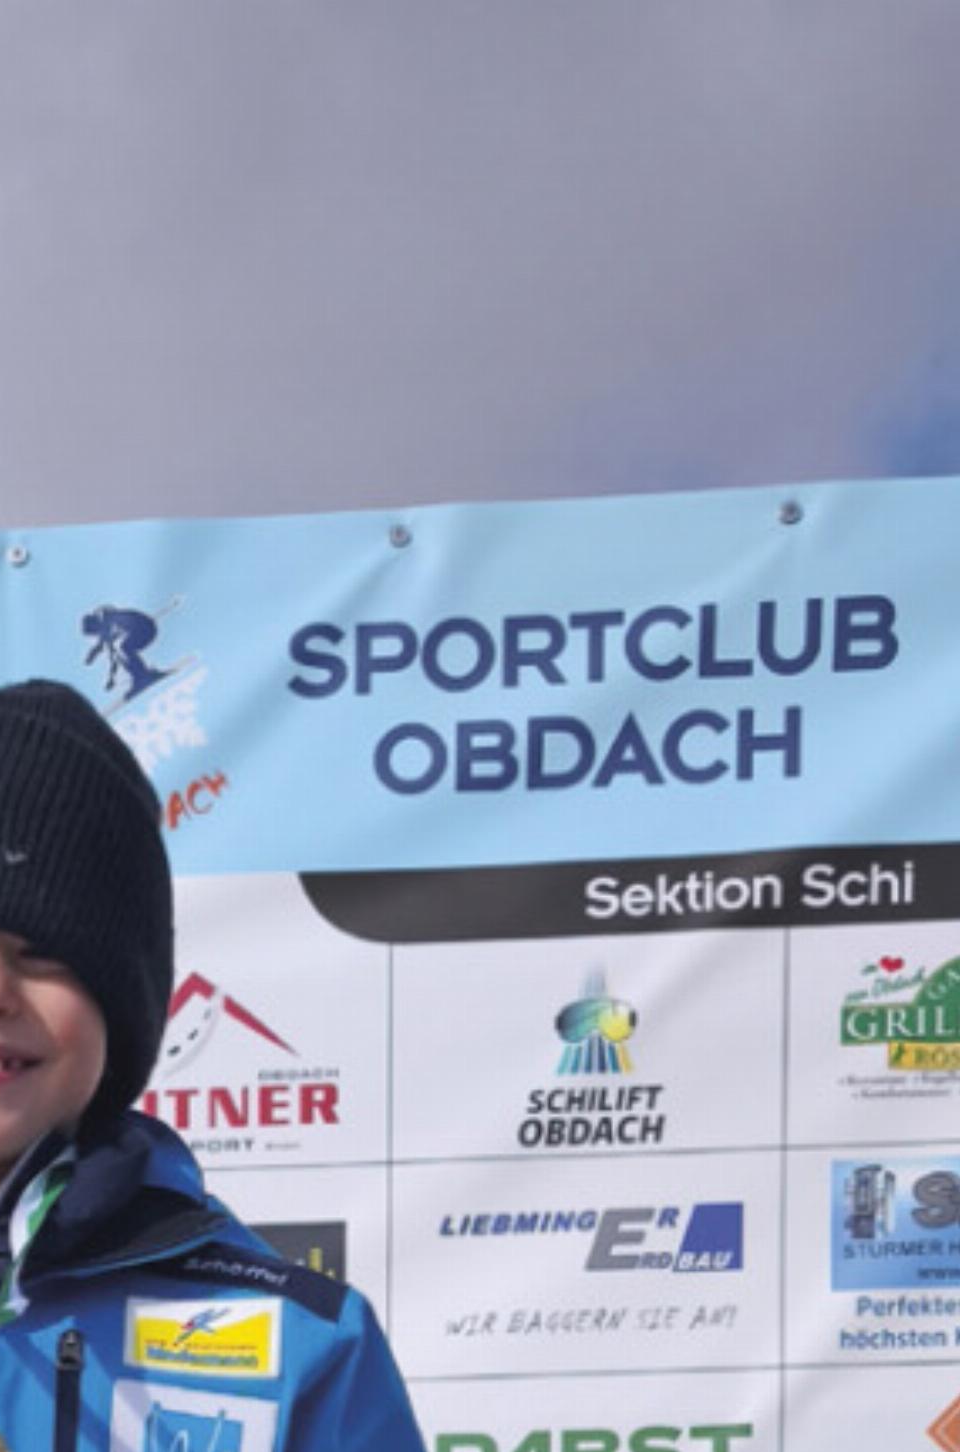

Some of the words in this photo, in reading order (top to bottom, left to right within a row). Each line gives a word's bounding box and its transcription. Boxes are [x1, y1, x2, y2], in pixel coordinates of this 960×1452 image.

[286, 594, 900, 699] SPORTCLUB
[372, 705, 803, 795] OBDACH
[585, 869, 782, 919] Sektion
[801, 860, 914, 908] Schi
[527, 1085, 664, 1114] SCHILIFT
[517, 1114, 666, 1149] OBDACH
